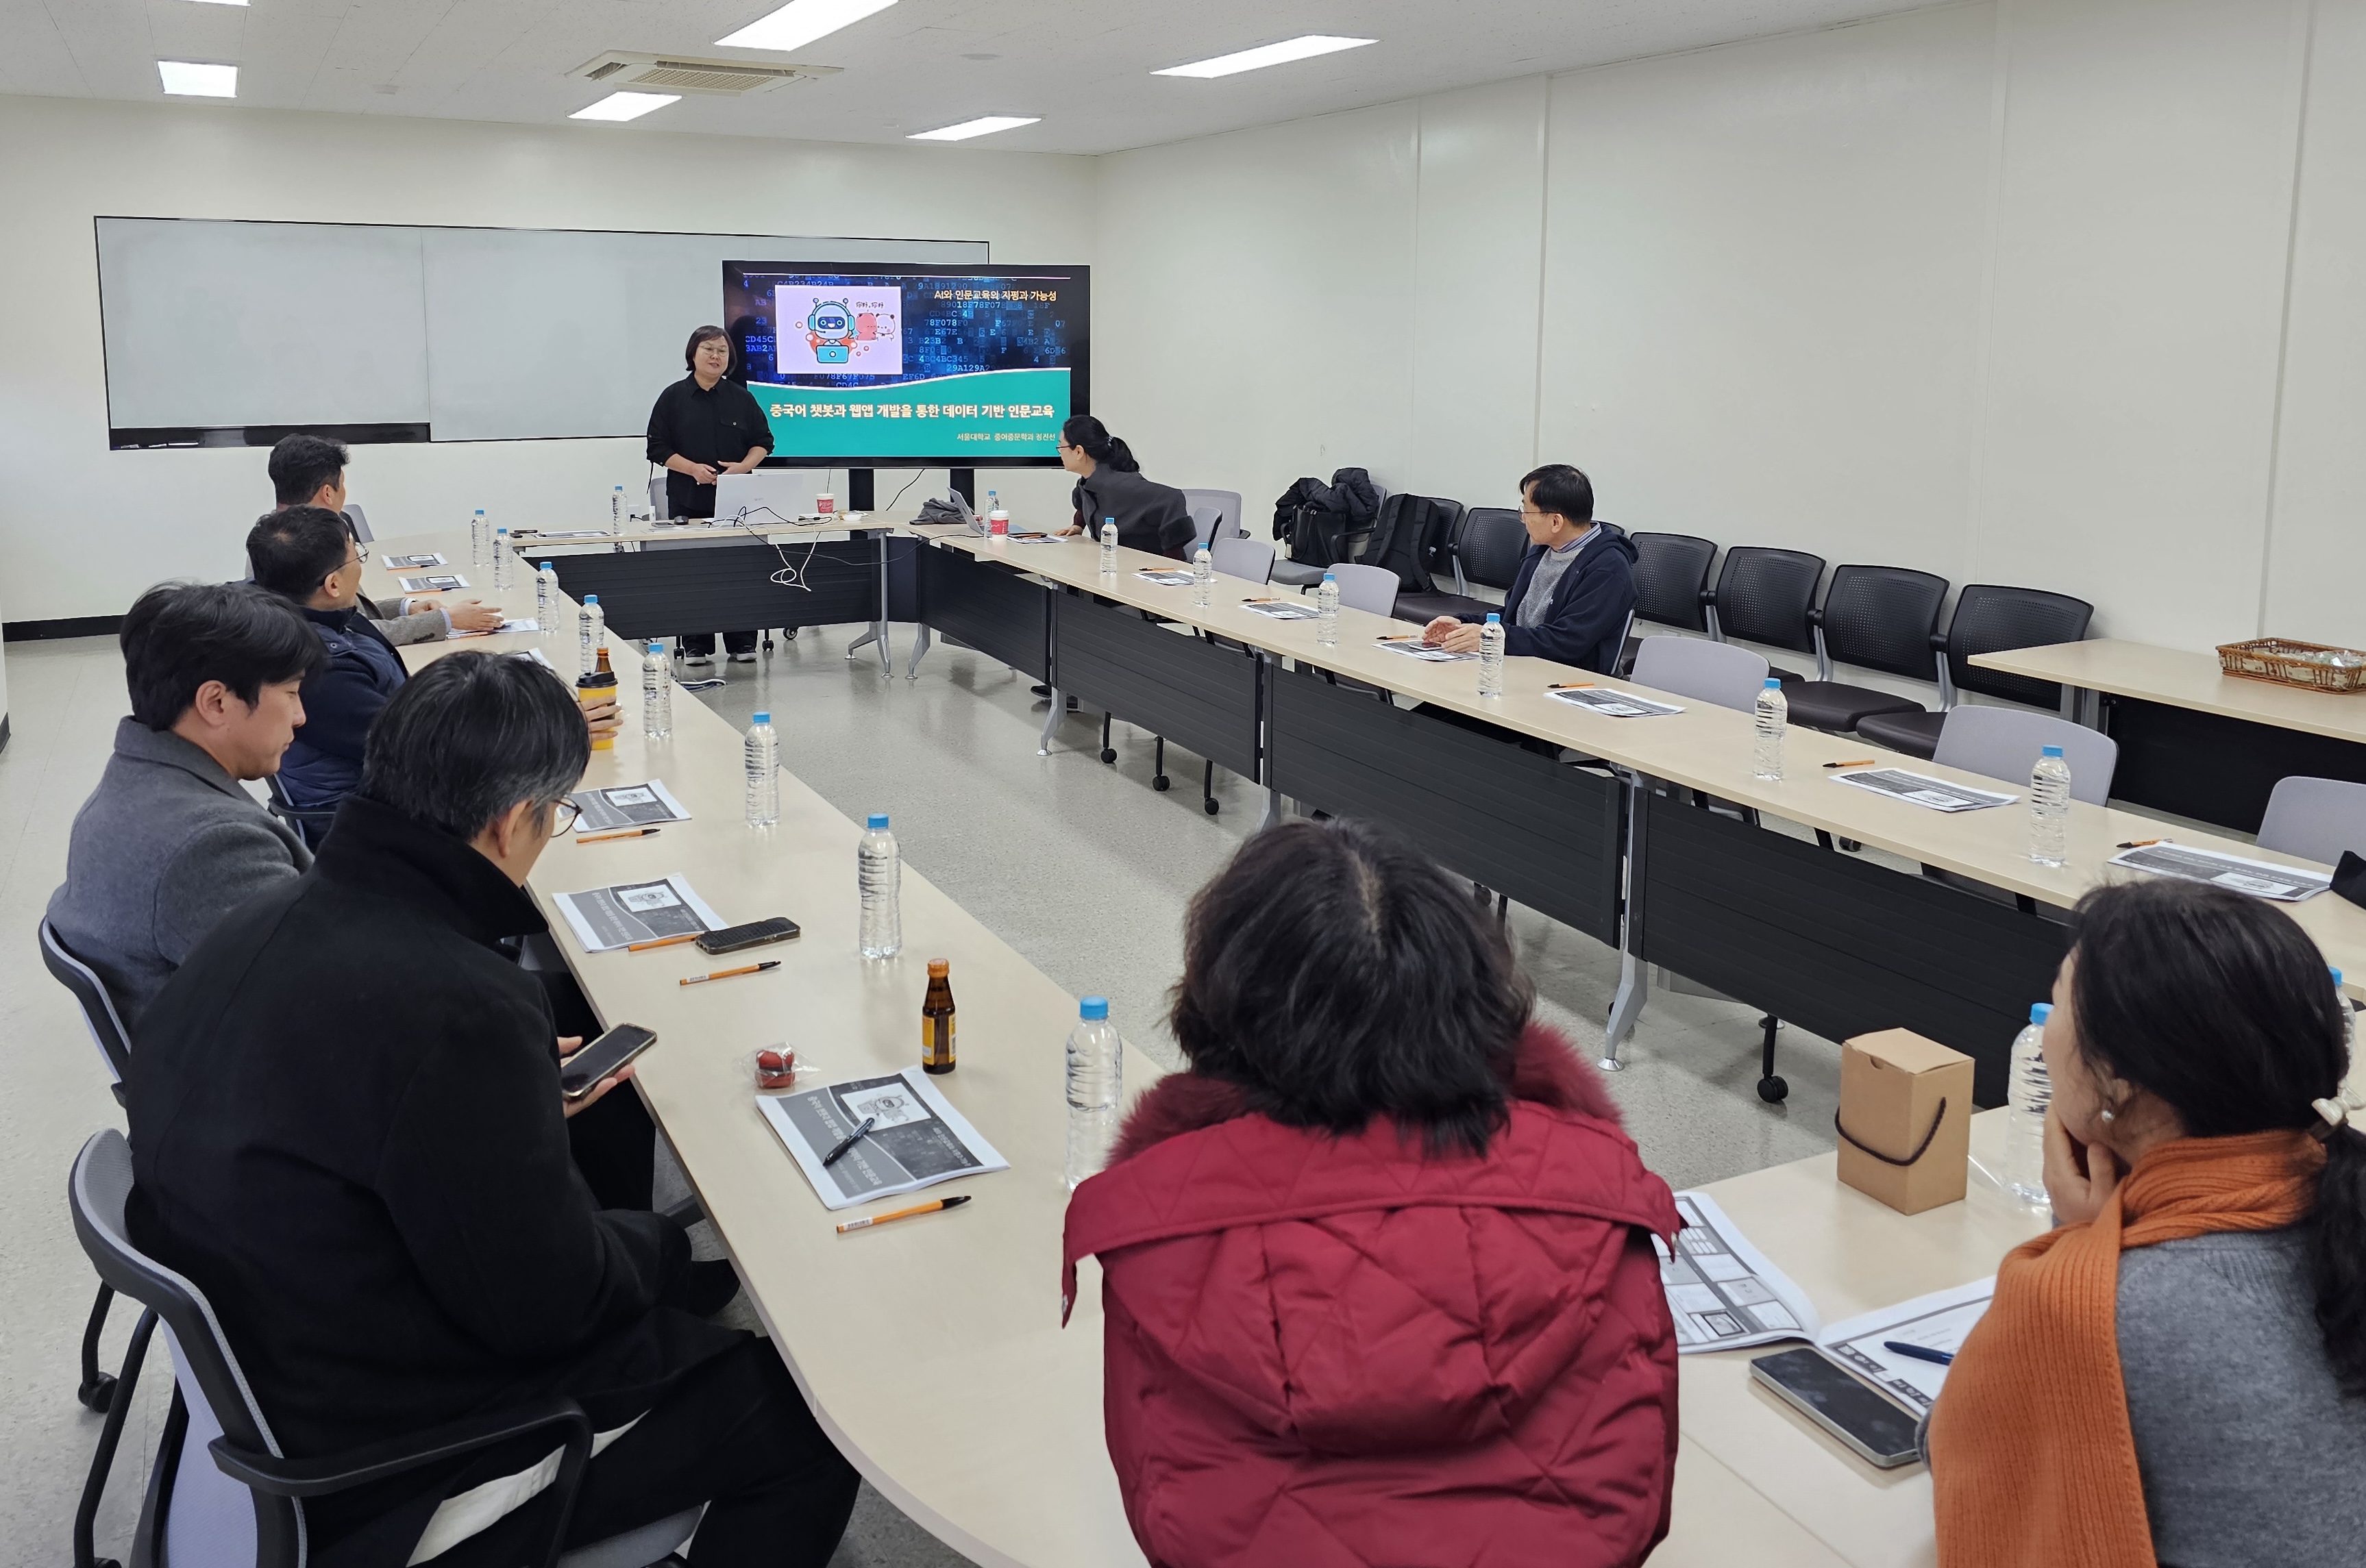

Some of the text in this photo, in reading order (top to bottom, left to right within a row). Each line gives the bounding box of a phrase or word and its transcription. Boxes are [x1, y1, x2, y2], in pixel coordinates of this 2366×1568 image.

[934, 290, 1057, 301] AI와 인문교육의 지평과 가능성
[769, 403, 1055, 419] 중국어 챗봇과 웹앱 개발을 통한 데이터 기반 인문교육
[957, 433, 990, 441] 서울대학교
[994, 433, 1034, 441] 중어중문학과
